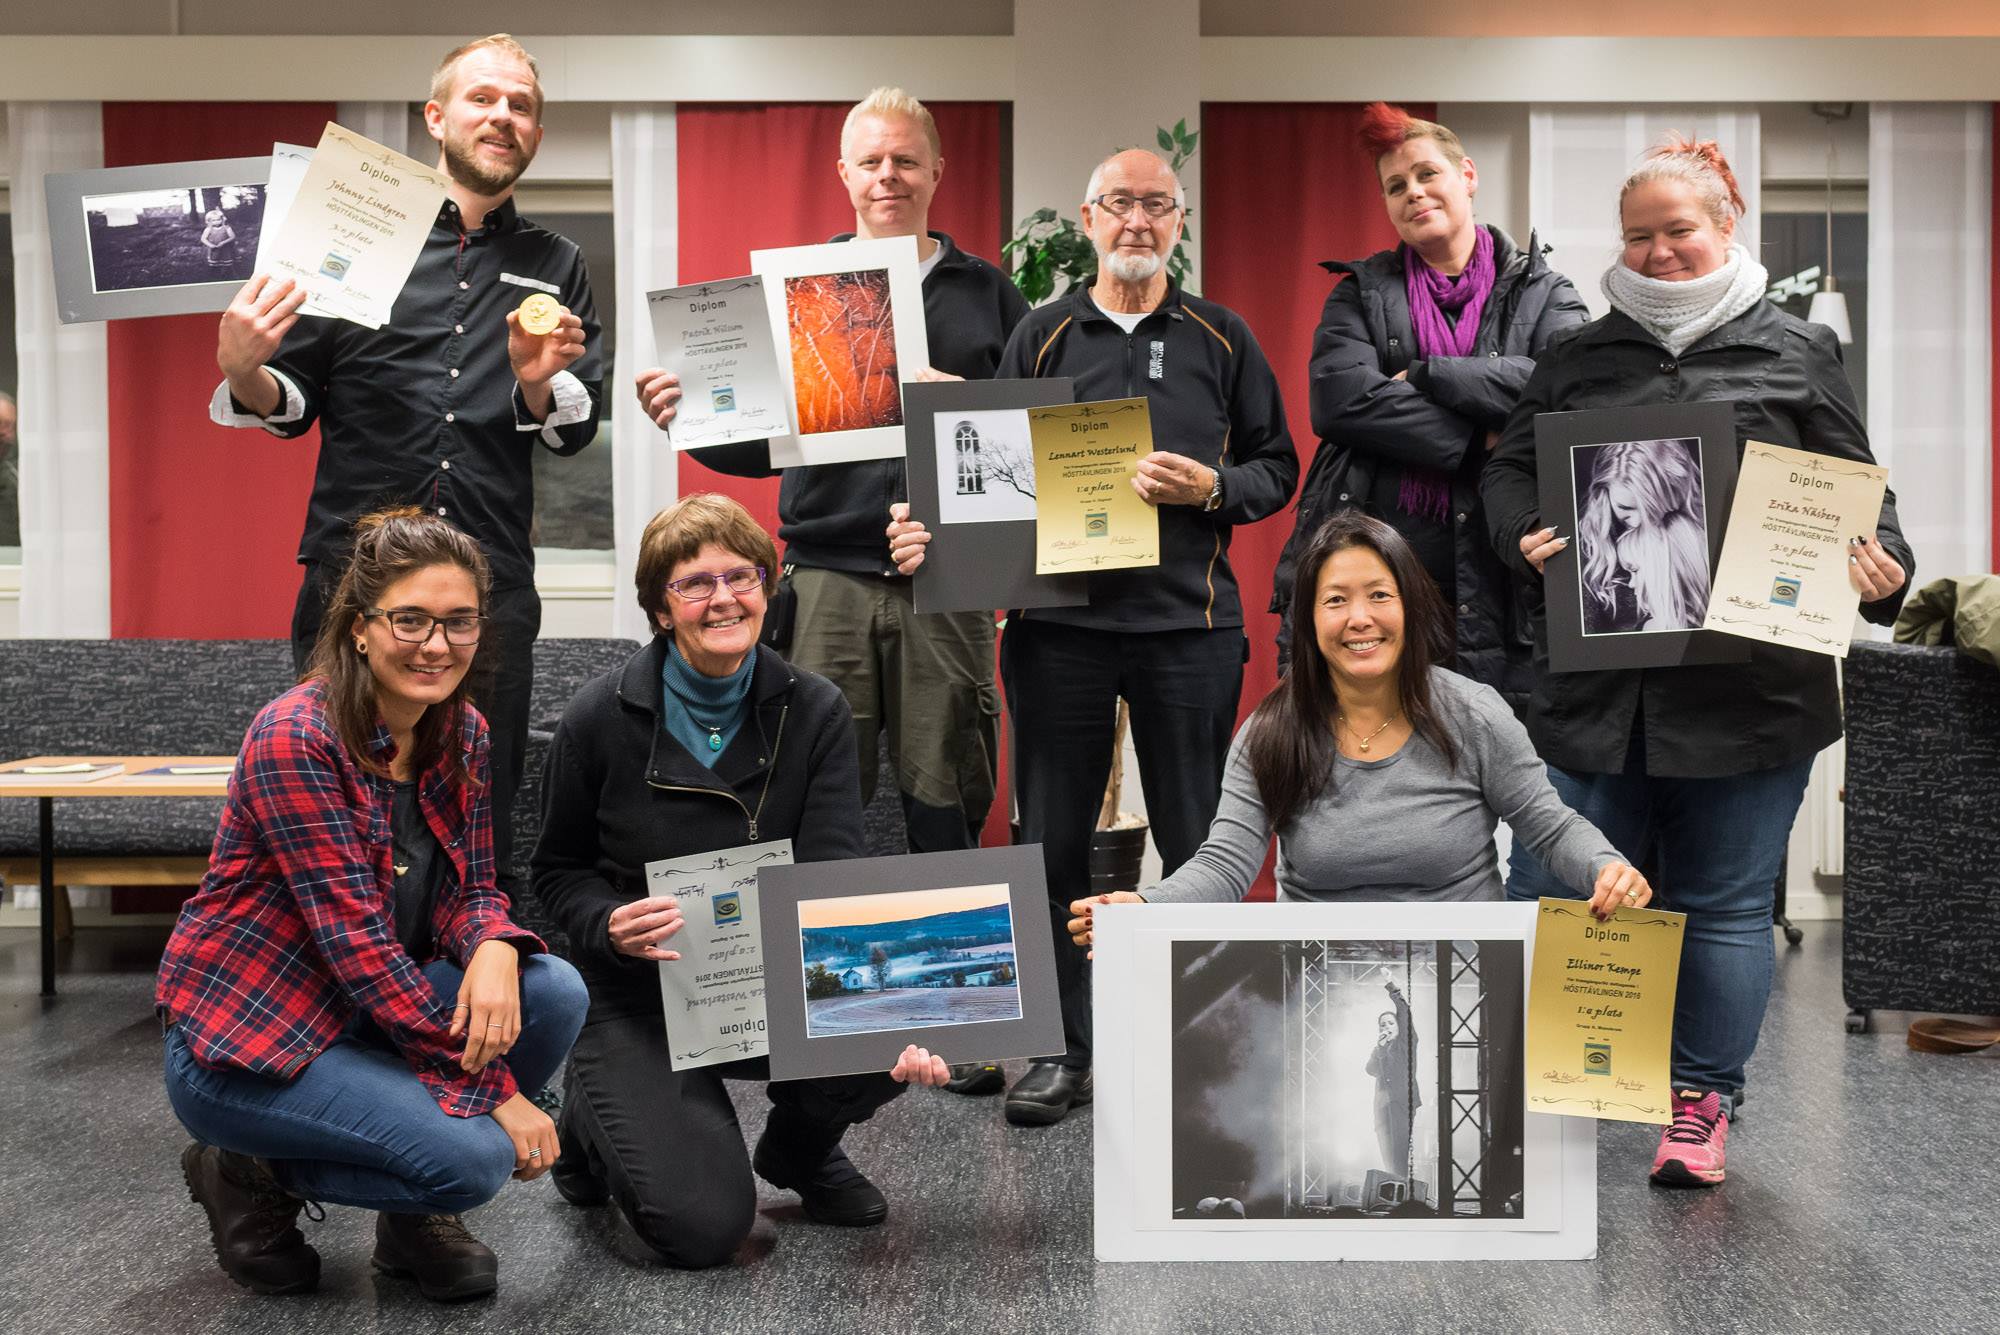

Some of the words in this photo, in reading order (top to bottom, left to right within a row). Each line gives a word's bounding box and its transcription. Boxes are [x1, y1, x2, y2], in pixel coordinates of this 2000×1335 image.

[360, 161, 400, 187] Diplom
[326, 179, 365, 206] Johnny
[365, 196, 407, 220] Lindgren
[690, 301, 727, 313] Diplom
[1071, 421, 1109, 434] Diplom
[1048, 450, 1086, 461] Lennart
[1087, 443, 1138, 456] Westerlund
[1088, 481, 1114, 496] plats
[1790, 472, 1834, 491] Diplom
[1768, 499, 1799, 513] Erika
[1762, 522, 1821, 540] HÖSTTÄVLINGEN
[1786, 545, 1819, 559] plats
[1585, 927, 1630, 942] Diplom
[708, 944, 738, 962] plats
[712, 964, 764, 980] STTÄVLINGEN
[1566, 958, 1605, 971] Ellinor
[1607, 962, 1642, 982] Kempe
[1563, 984, 1624, 998] HÖSTTÄVLINGEN
[685, 991, 747, 1012] Westerlund
[1590, 1005, 1623, 1020] plats
[720, 1019, 766, 1035] Diplom
